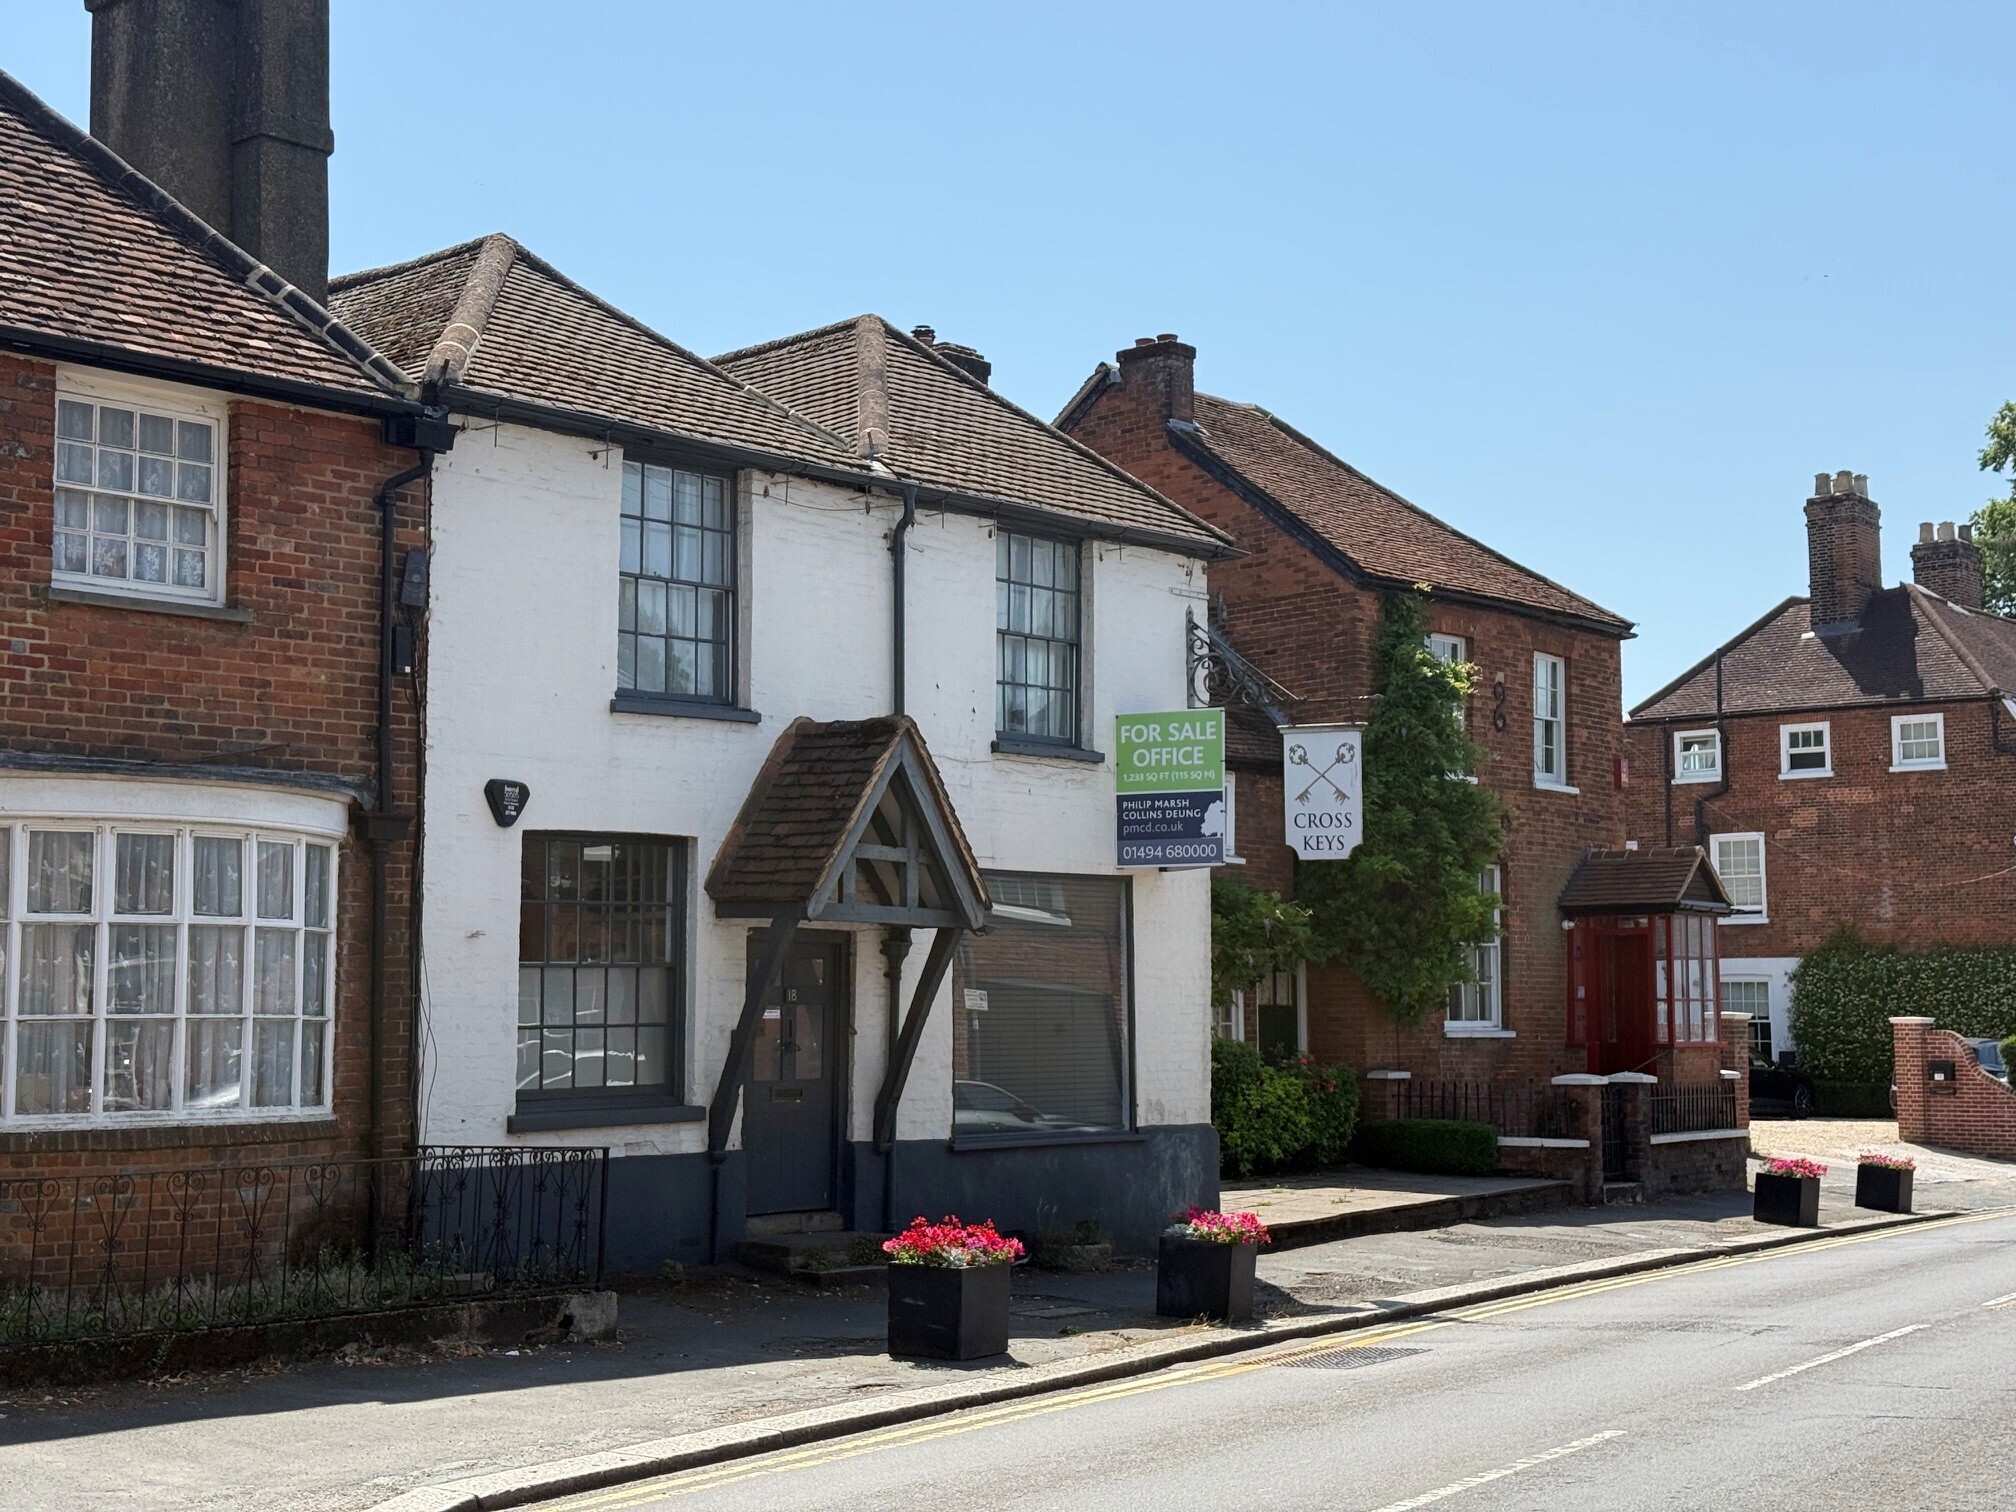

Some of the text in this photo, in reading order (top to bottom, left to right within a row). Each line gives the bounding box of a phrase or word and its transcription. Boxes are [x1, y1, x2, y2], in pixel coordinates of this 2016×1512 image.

[1120, 721, 1216, 743] FOR SALE
[1132, 746, 1204, 767] OFFICE
[1123, 769, 1215, 783] 1,233 SQ FT (115 SQ M)
[1122, 799, 1189, 809] PHILIP MARSH
[1122, 809, 1201, 820] COLLINS DEUNG
[1294, 812, 1352, 829] CROSS
[1123, 821, 1184, 836] pmcd.co.uk
[1303, 835, 1345, 851] KEYS
[1123, 844, 1217, 859] 01494 680000
[788, 989, 797, 1001] 18
